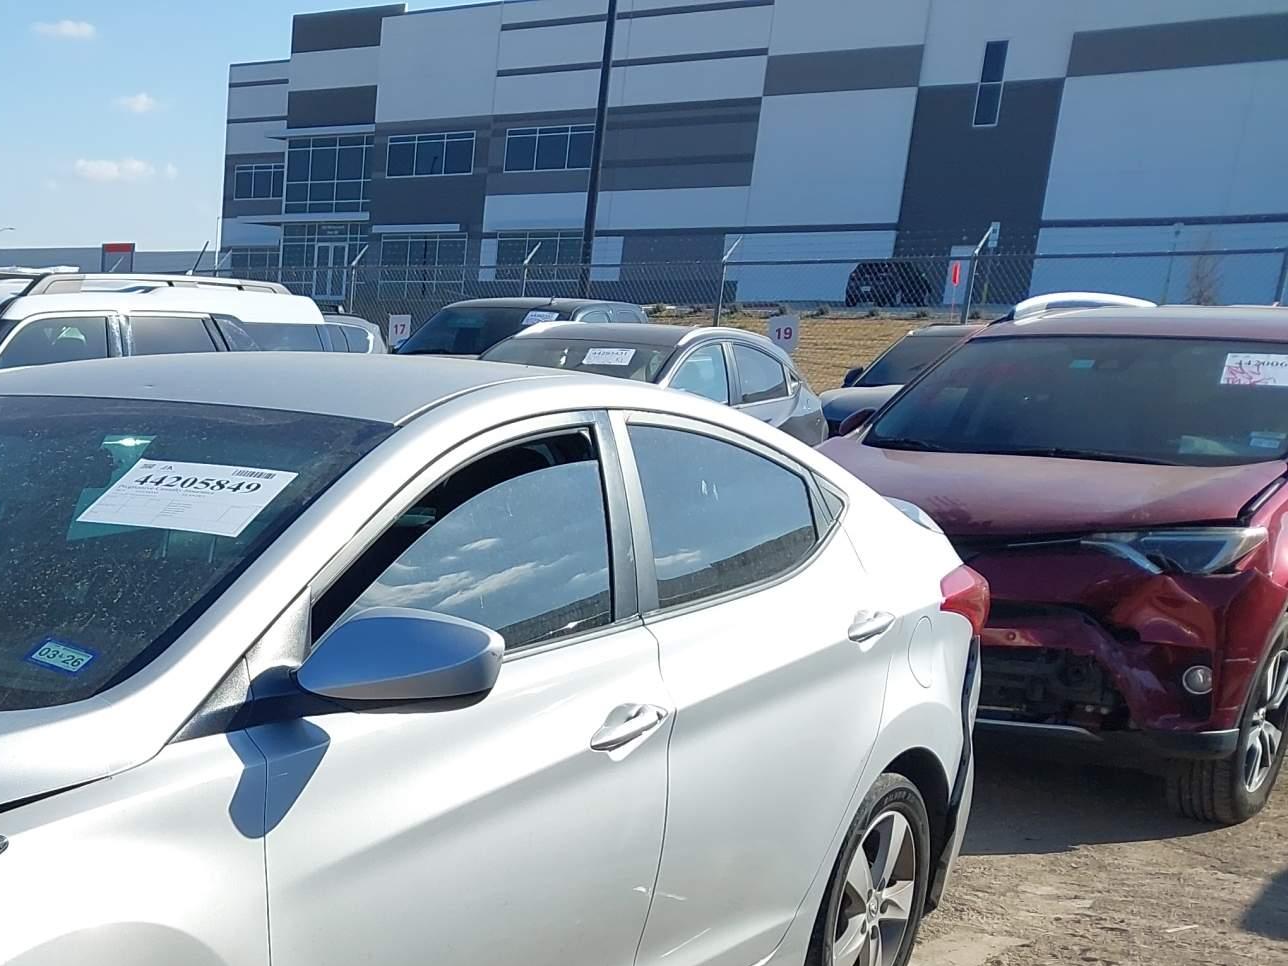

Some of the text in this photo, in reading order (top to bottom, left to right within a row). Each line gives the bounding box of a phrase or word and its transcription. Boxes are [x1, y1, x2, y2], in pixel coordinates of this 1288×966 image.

[394, 324, 406, 336] 17
[775, 326, 793, 340] 19
[134, 474, 262, 494] 44205849
